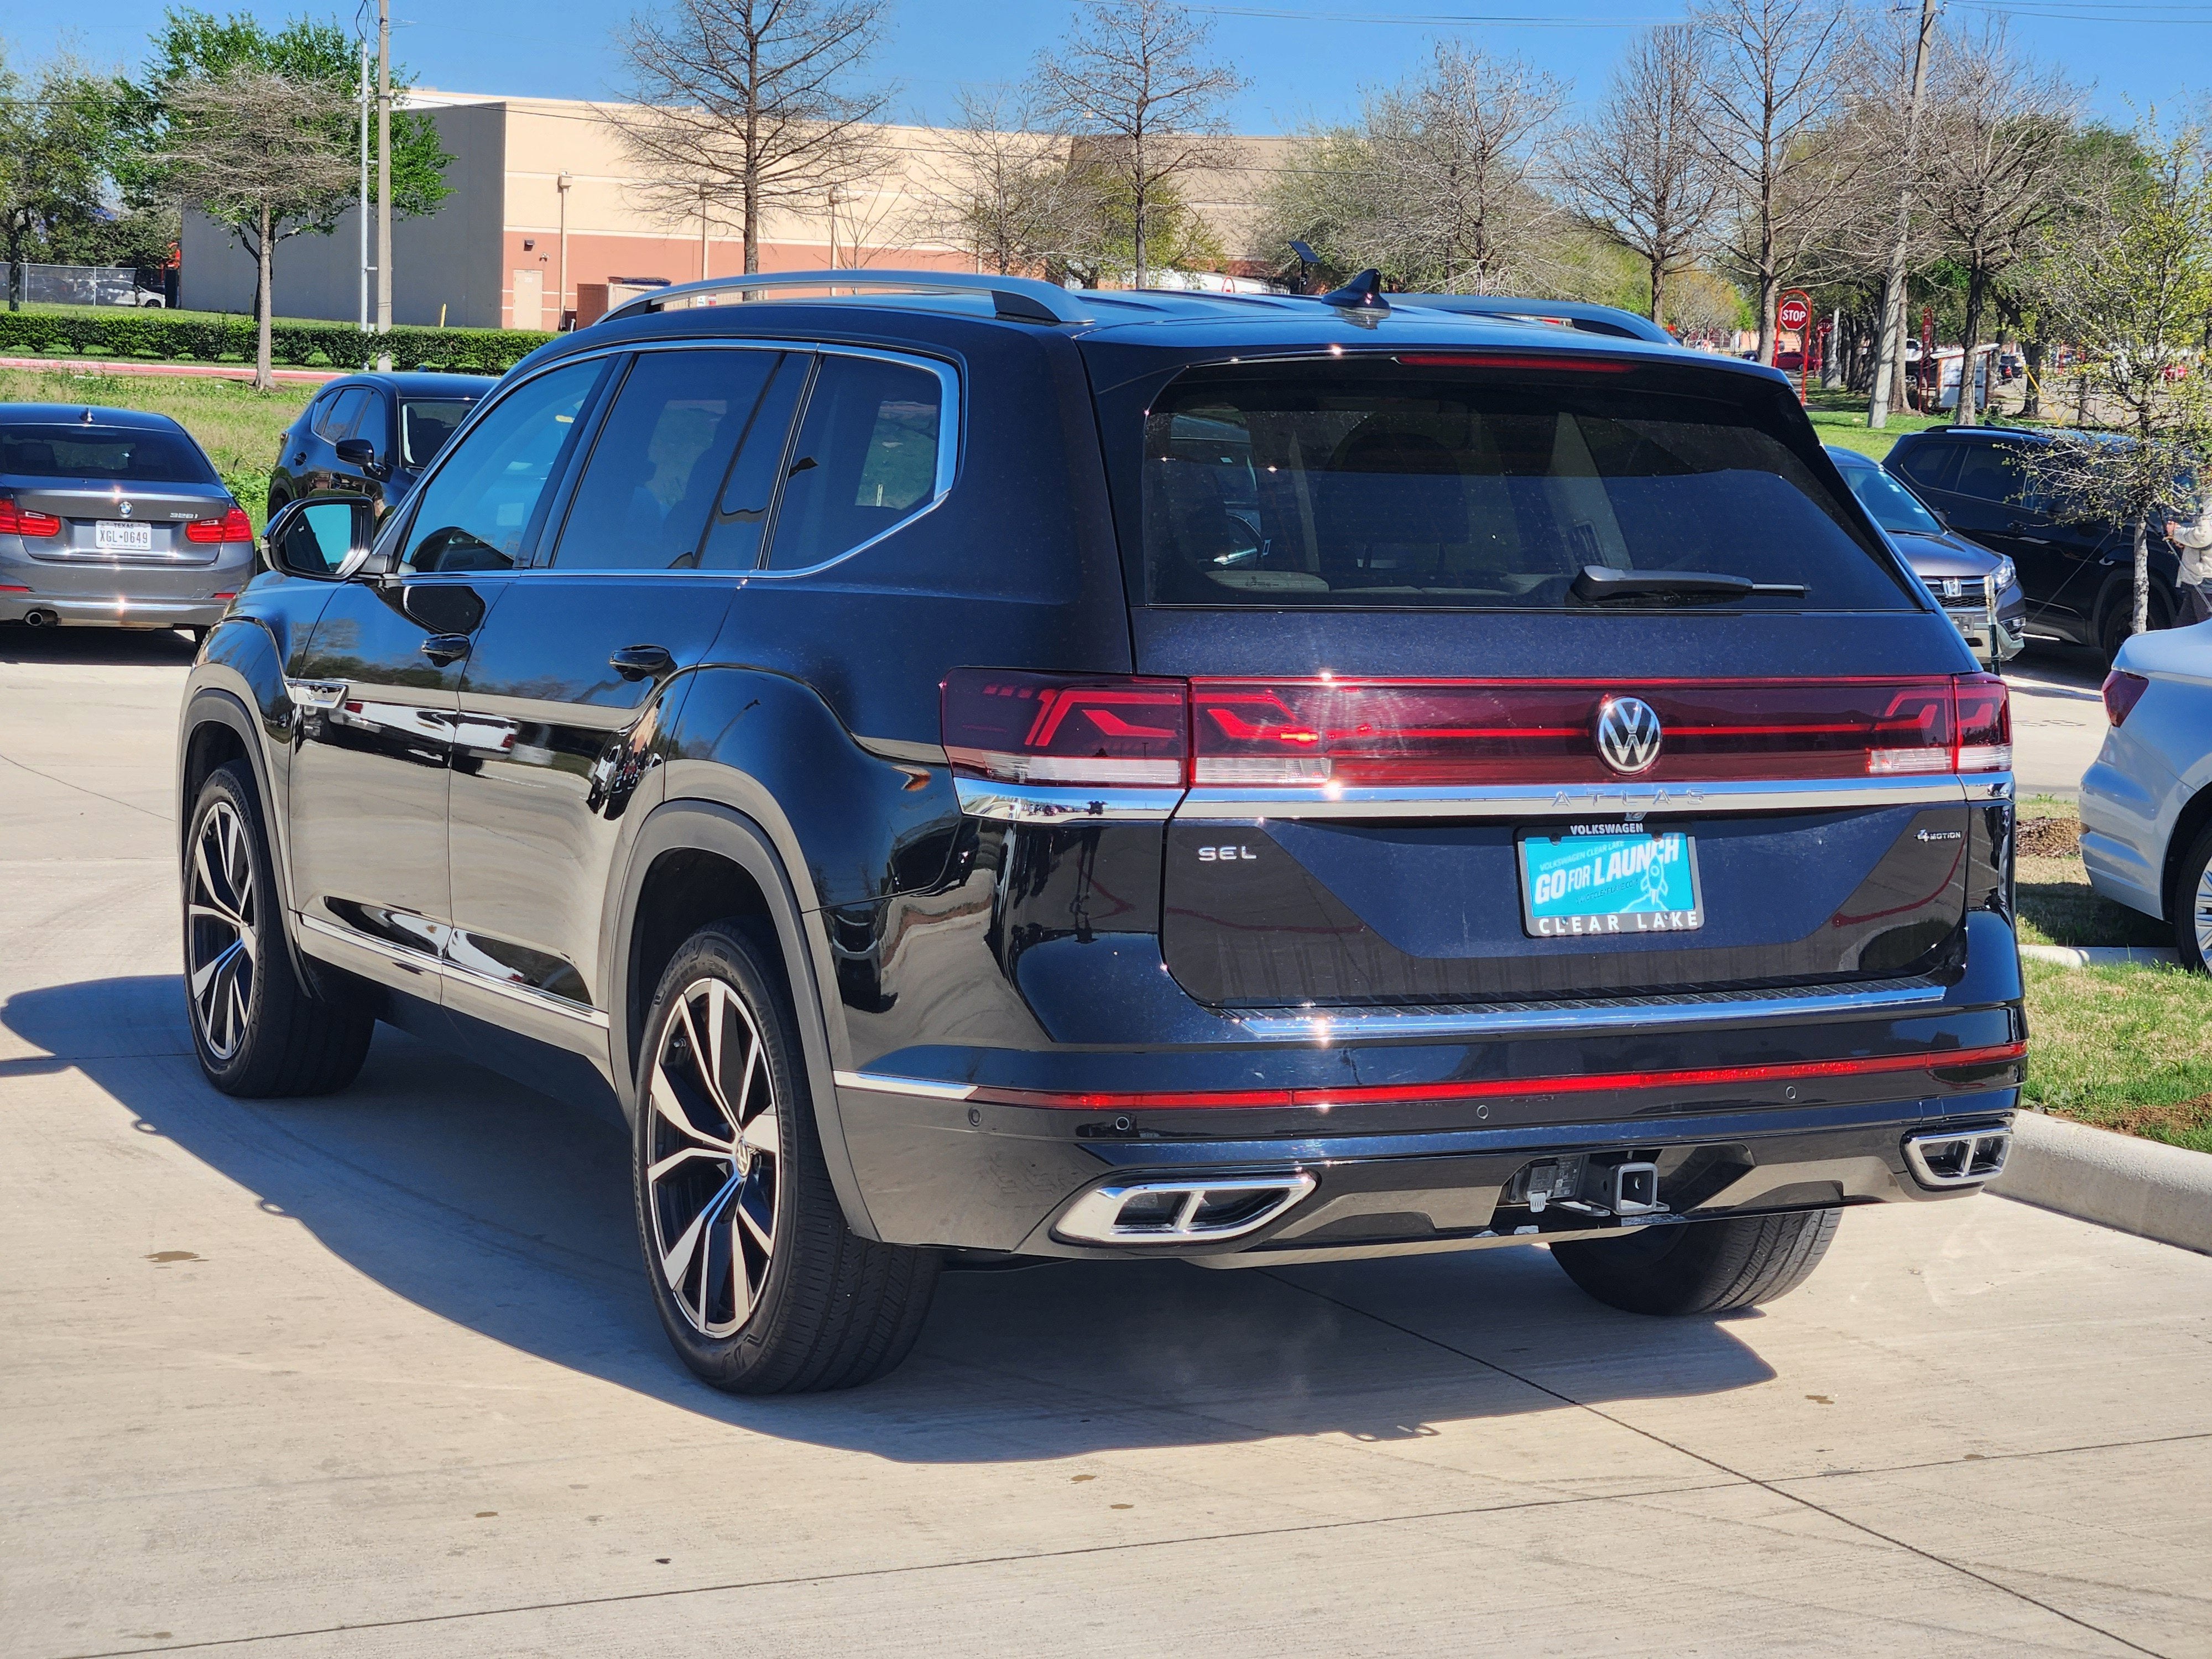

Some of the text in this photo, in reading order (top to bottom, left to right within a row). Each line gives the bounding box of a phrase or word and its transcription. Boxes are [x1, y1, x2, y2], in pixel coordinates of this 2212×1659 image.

[1782, 310, 1806, 321] STOP
[1552, 788, 1704, 807] ATLAS
[1570, 822, 1644, 835] VOLKSWAGEN
[1916, 829, 1961, 842] 4MOTION
[1198, 846, 1257, 861] SEL
[1540, 841, 1624, 871] VOLKSWAGEN CLEAR LAKE
[1535, 833, 1680, 905] GO FOR LAUNCH
[1538, 911, 1698, 935] CLEAR LAKE
